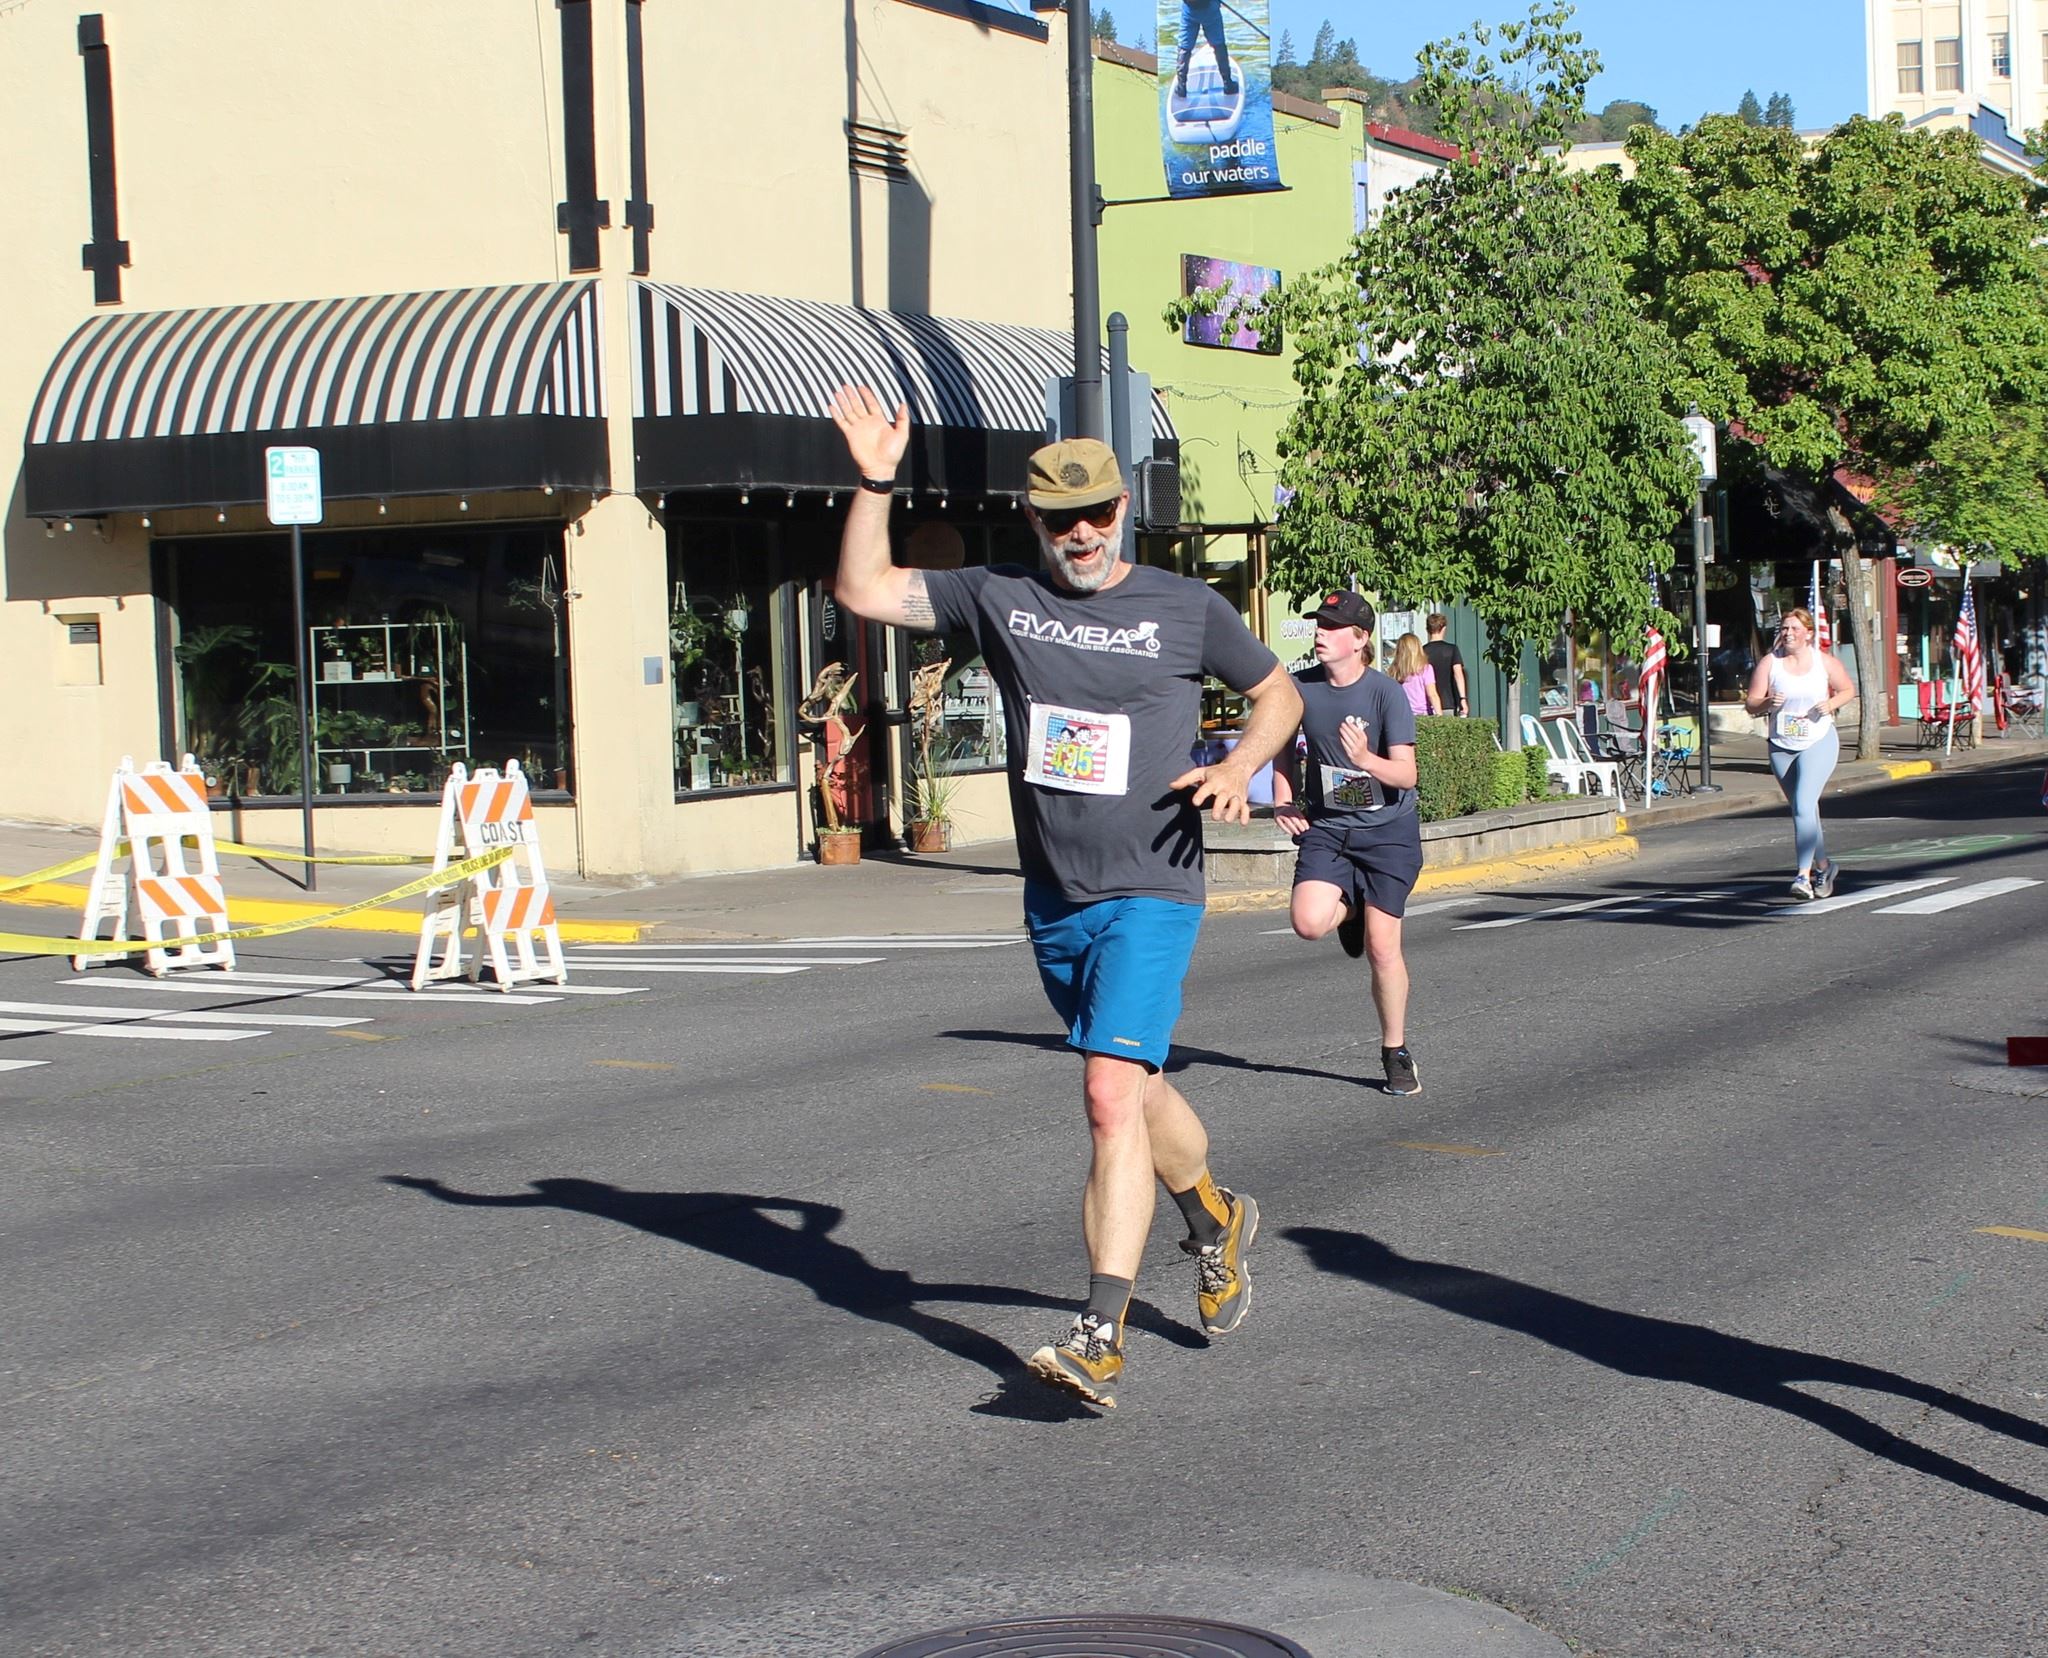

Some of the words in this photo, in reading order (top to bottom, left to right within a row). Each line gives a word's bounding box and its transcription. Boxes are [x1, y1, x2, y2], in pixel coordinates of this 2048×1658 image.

[1209, 138, 1266, 164] paddle
[1182, 170, 1210, 185] our
[1213, 166, 1270, 183] waters
[271, 455, 283, 473] 2
[1008, 609, 1132, 649] RVMBA
[1281, 619, 1317, 639] COSMIC
[1029, 632, 1055, 644] VALLEY
[1055, 638, 1092, 651] MOUNTAIN
[1093, 644, 1110, 653] BIKE
[1110, 646, 1159, 660] ASSOCIATION
[1050, 742, 1094, 777] 425
[479, 821, 526, 844] COAST
[461, 857, 480, 874] POLICE
